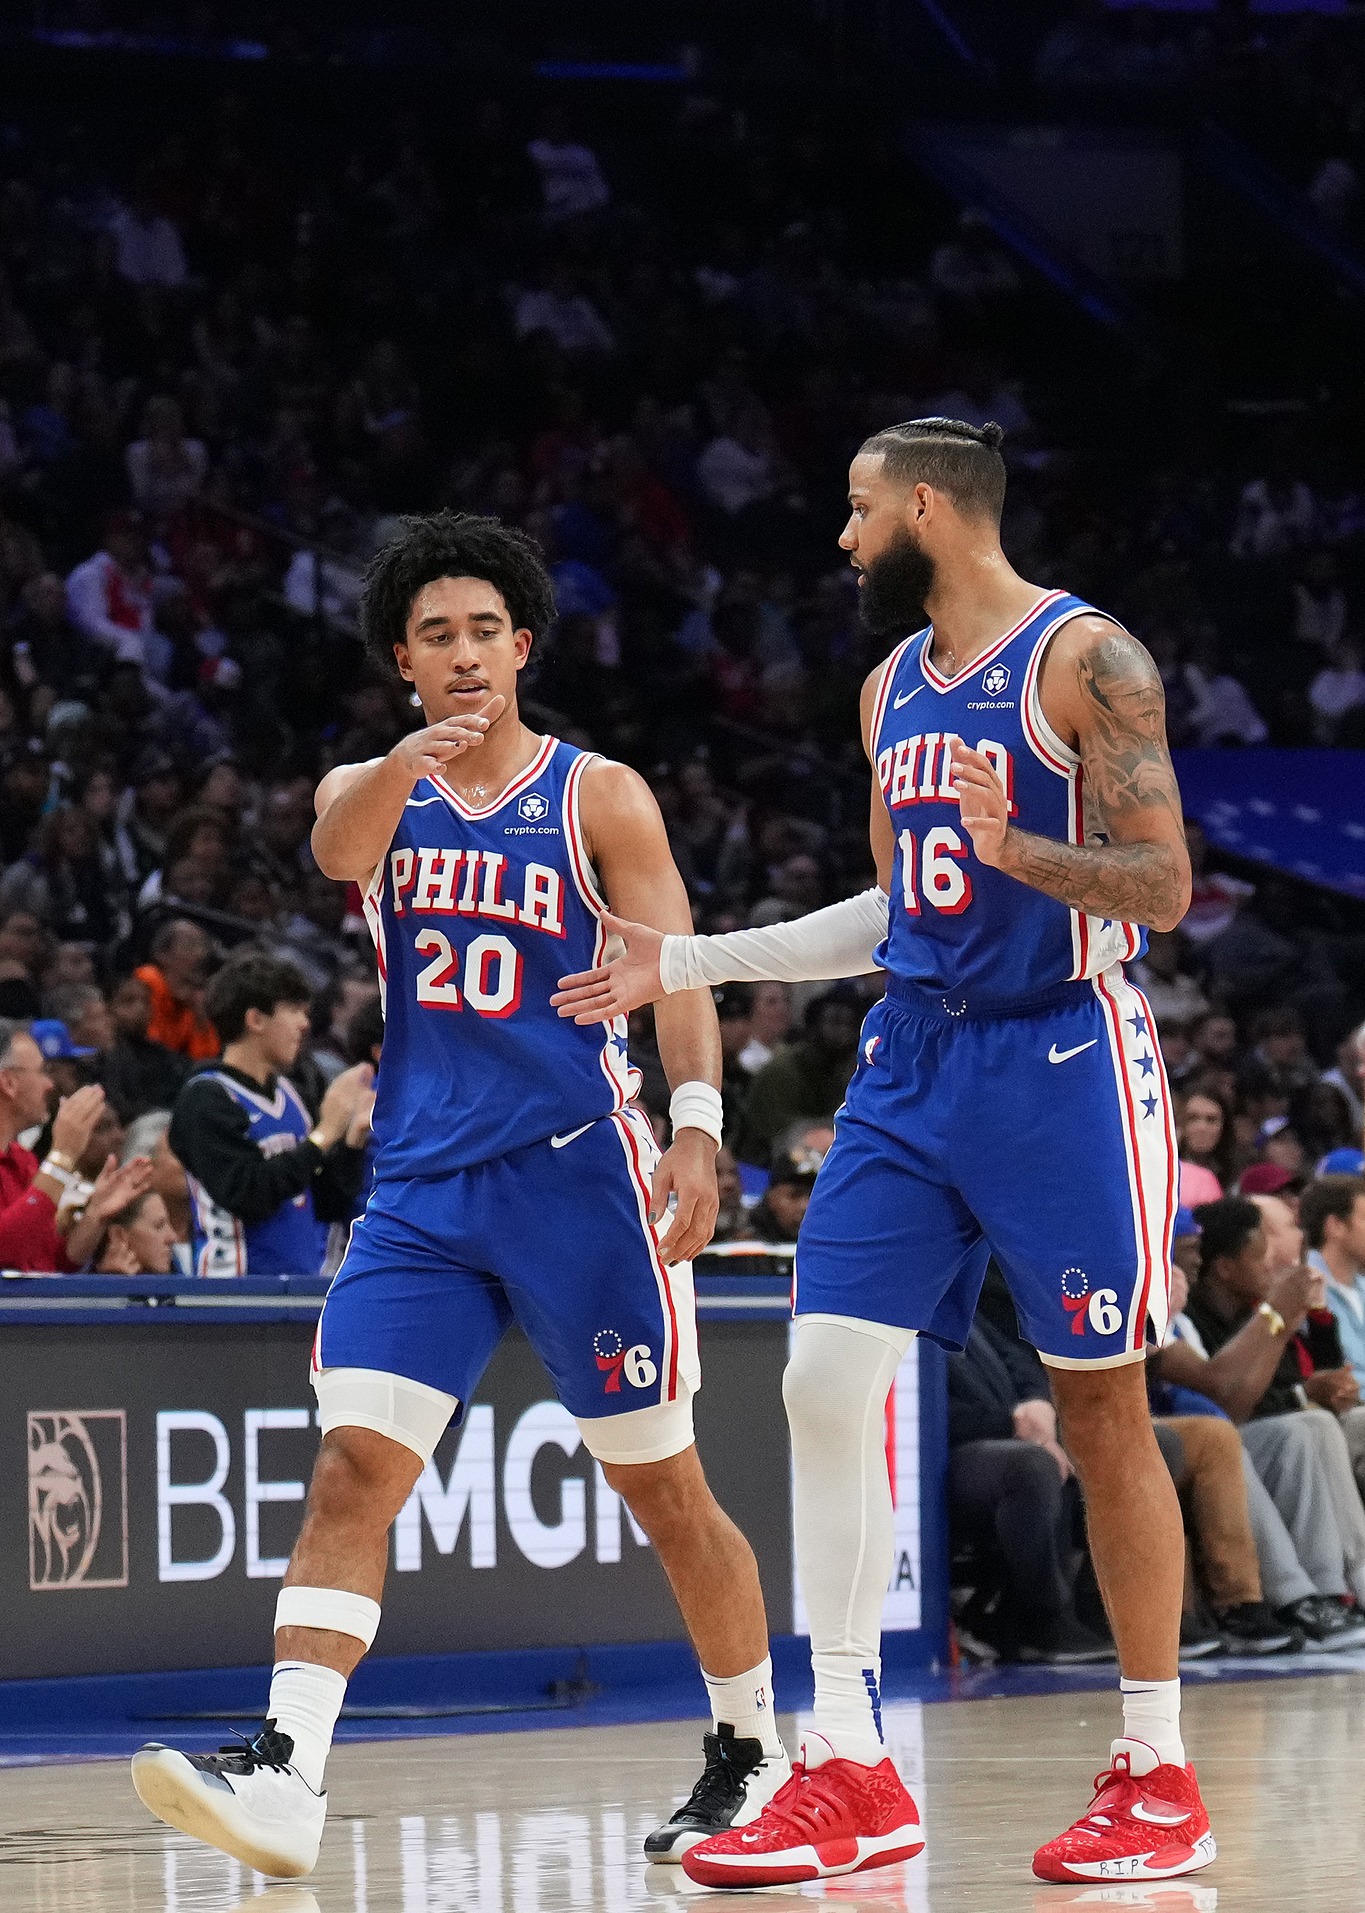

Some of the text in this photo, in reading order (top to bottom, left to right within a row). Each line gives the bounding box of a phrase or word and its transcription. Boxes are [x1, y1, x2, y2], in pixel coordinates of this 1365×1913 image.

[967, 700, 1015, 711] crypto.com
[504, 824, 560, 836] crypto.com
[390, 847, 567, 940] PHILA
[898, 826, 973, 917] 16
[415, 928, 524, 1019] 20
[1061, 1288, 1123, 1337] 76
[595, 1344, 658, 1394] 76
[156, 1399, 651, 1582] BEMG
